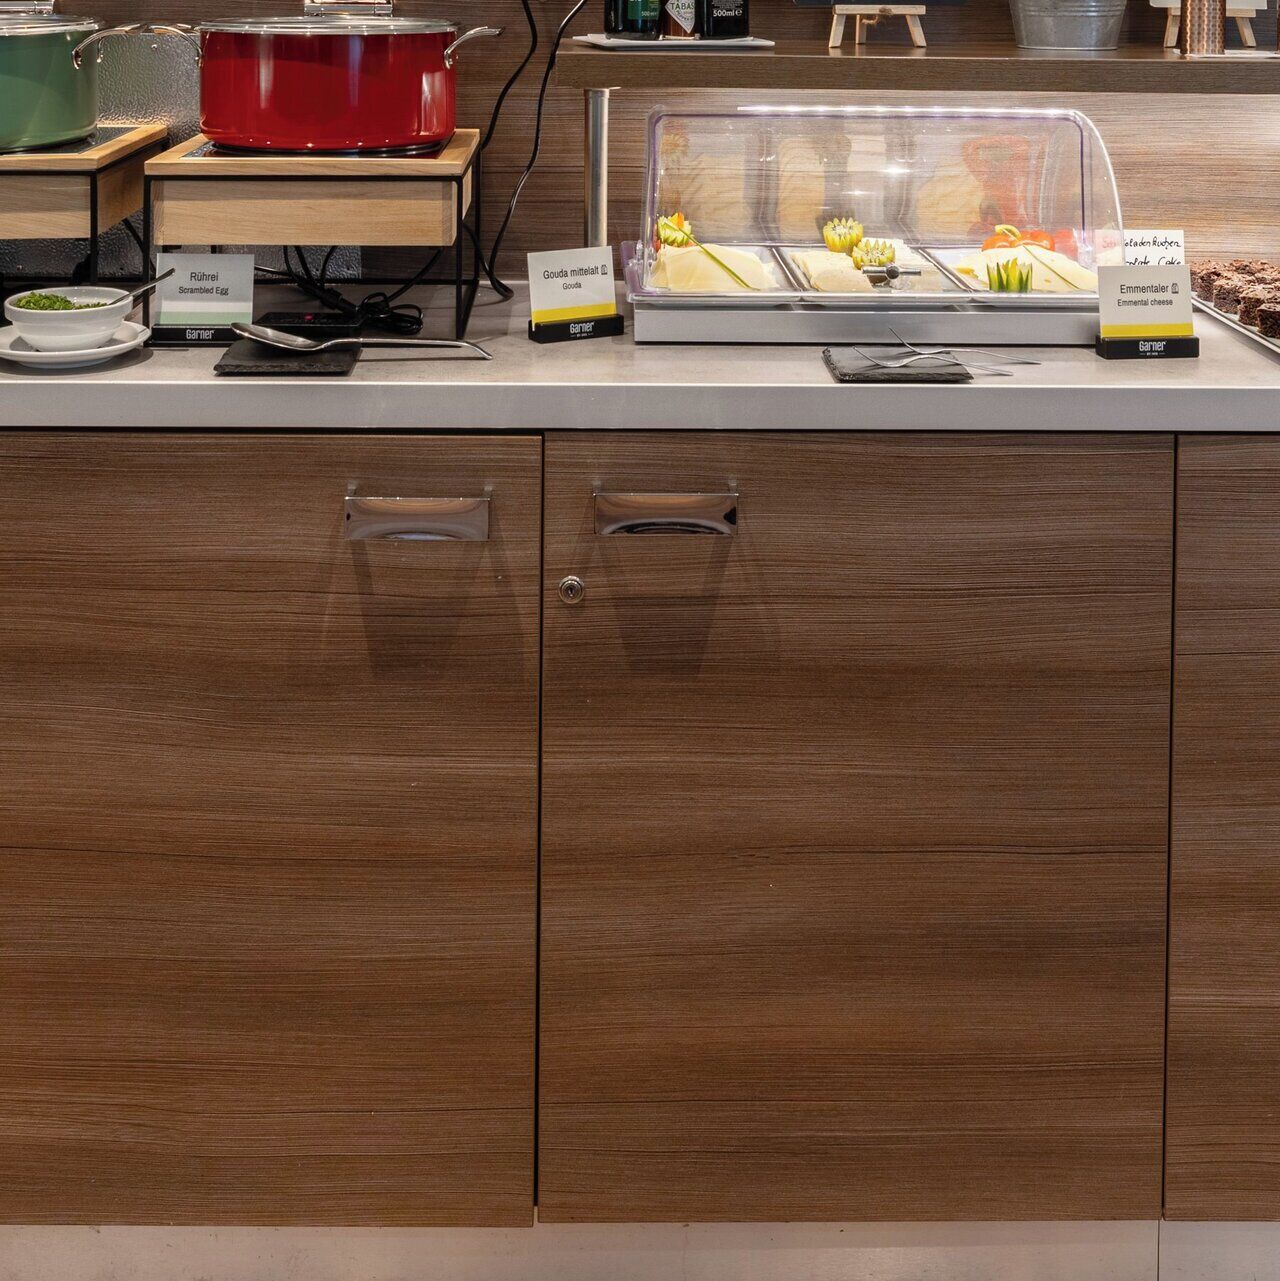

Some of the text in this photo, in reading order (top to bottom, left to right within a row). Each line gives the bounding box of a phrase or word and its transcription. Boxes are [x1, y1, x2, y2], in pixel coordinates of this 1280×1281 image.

[190, 272, 219, 282] Rührei
[542, 266, 599, 280] Gouda mittelalt
[215, 286, 229, 296] Egg
[562, 282, 582, 290] Gouda
[1120, 284, 1169, 294] Emmentaler
[1118, 298, 1150, 306] Emmental
[570, 321, 594, 334] Garner
[186, 329, 215, 340] Garner
[1138, 340, 1166, 352] Garner
